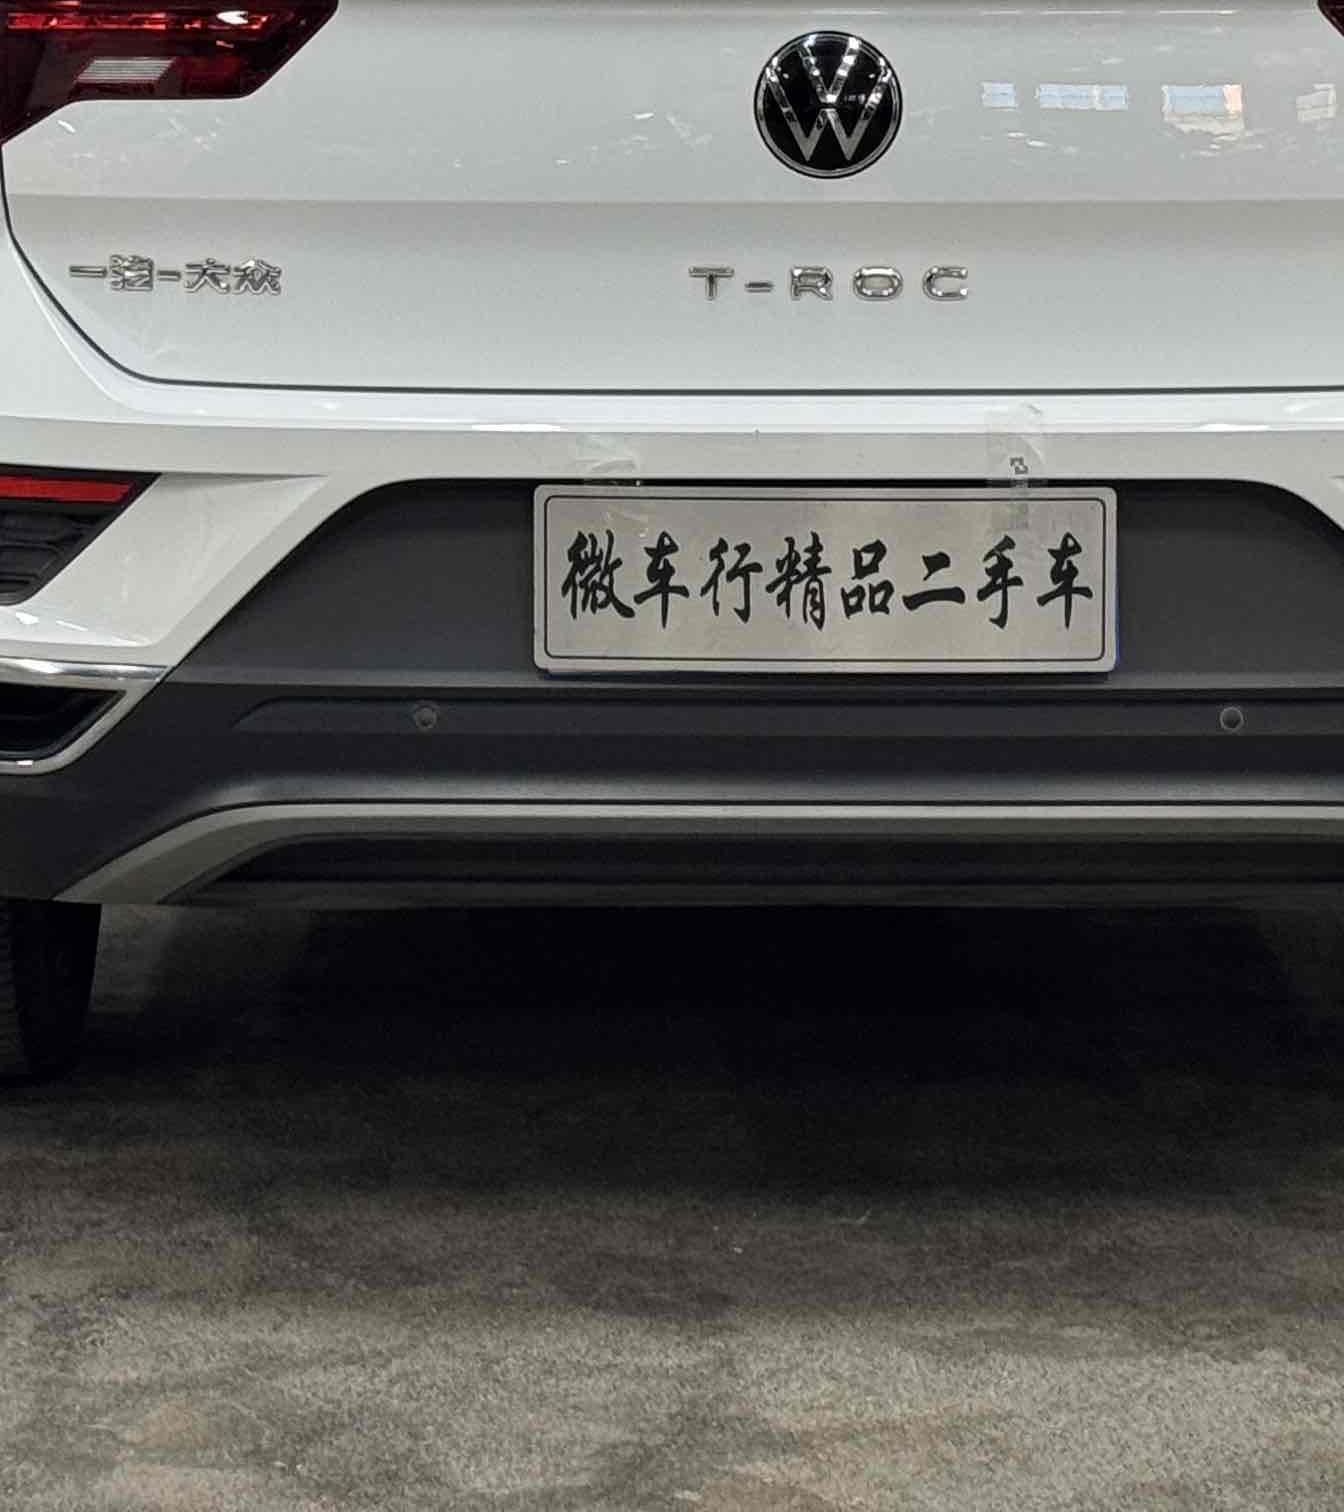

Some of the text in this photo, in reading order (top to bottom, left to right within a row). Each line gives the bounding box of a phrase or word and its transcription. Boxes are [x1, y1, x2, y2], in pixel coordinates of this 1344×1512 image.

[688, 266, 968, 300] T-ROC
[561, 530, 1093, 630] 微车行精品二手车
